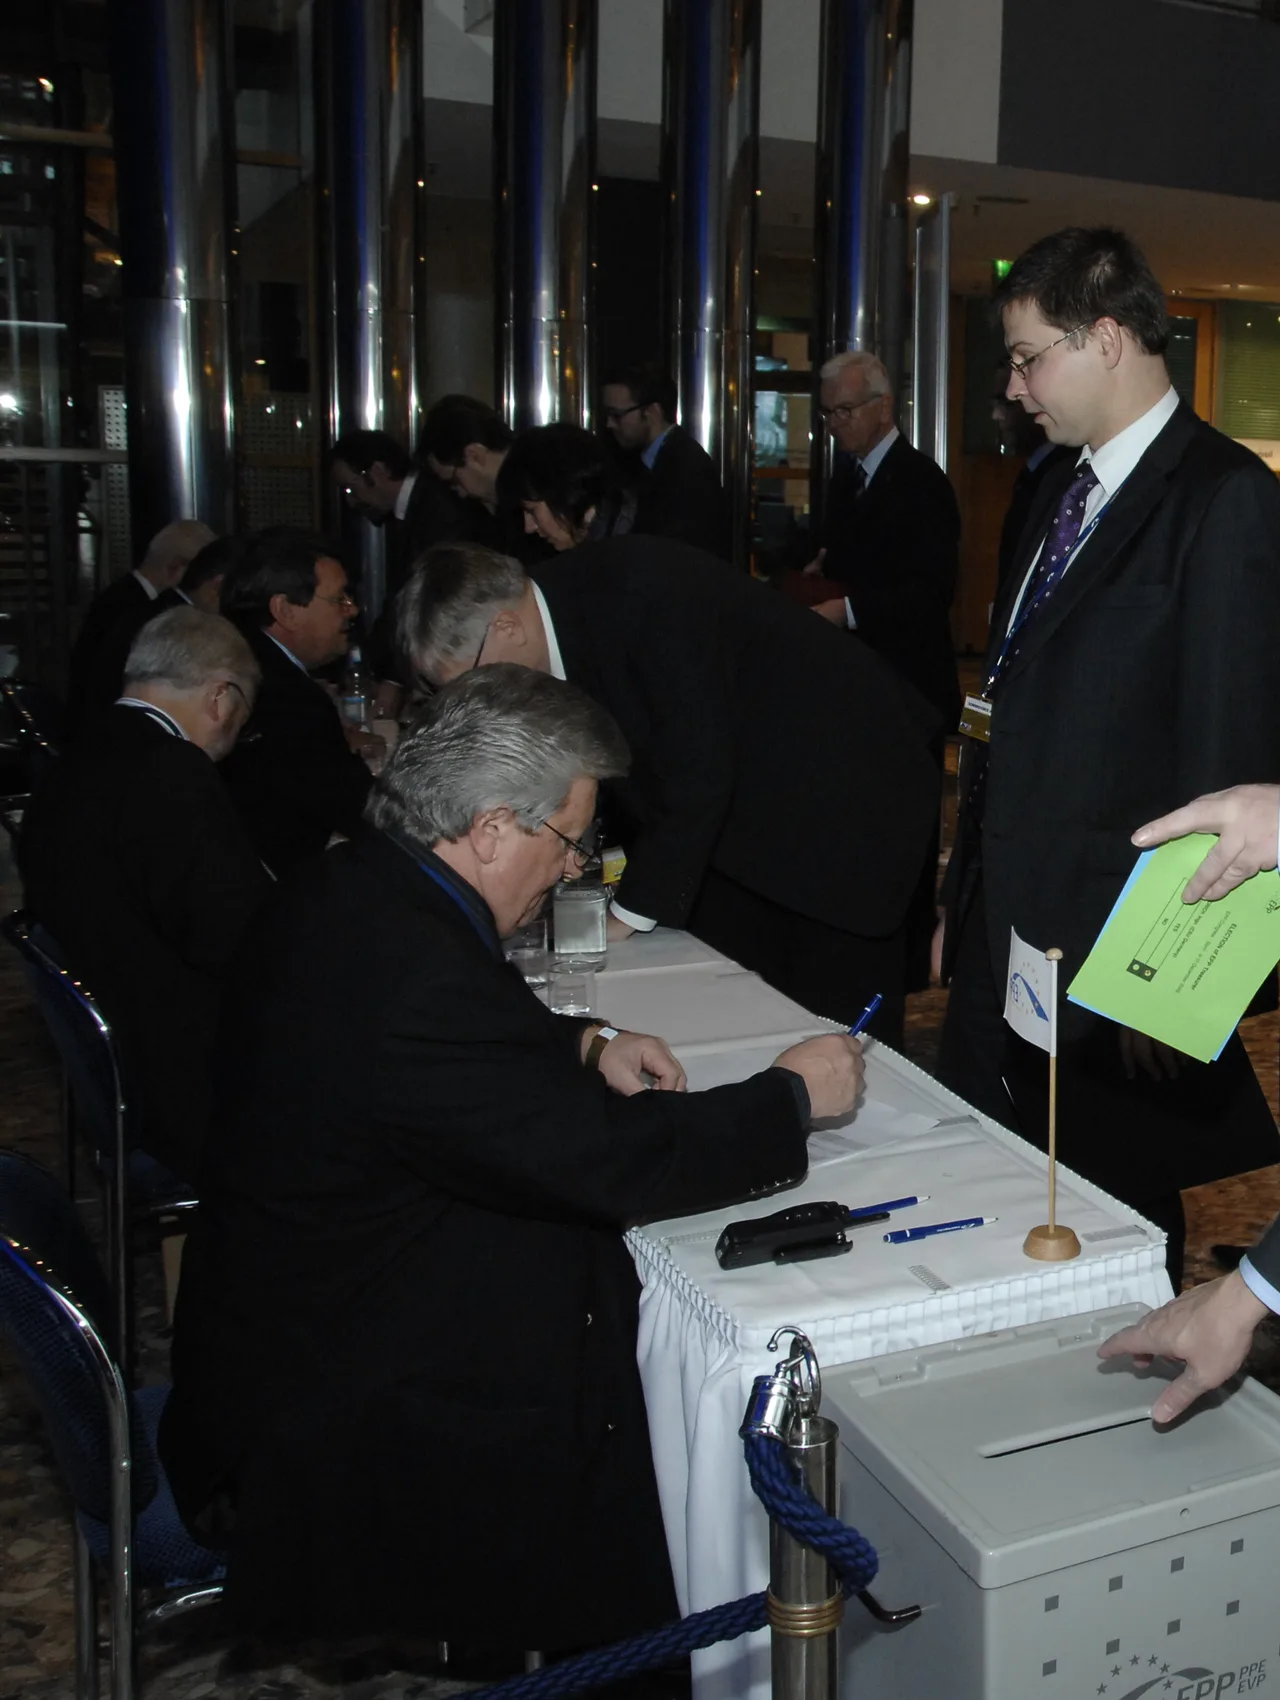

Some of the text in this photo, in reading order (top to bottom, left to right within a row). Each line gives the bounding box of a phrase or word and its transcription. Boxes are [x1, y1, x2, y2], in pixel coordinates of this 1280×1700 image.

[1266, 900, 1278, 914] EPP
[1161, 917, 1168, 926] NO
[1172, 922, 1181, 932] YES
[1216, 923, 1237, 949] ELECTION
[1206, 954, 1217, 967] EPP
[1191, 966, 1209, 990] Treasurer
[1239, 1659, 1267, 1680] PPE
[1237, 1674, 1267, 1694] EVP
